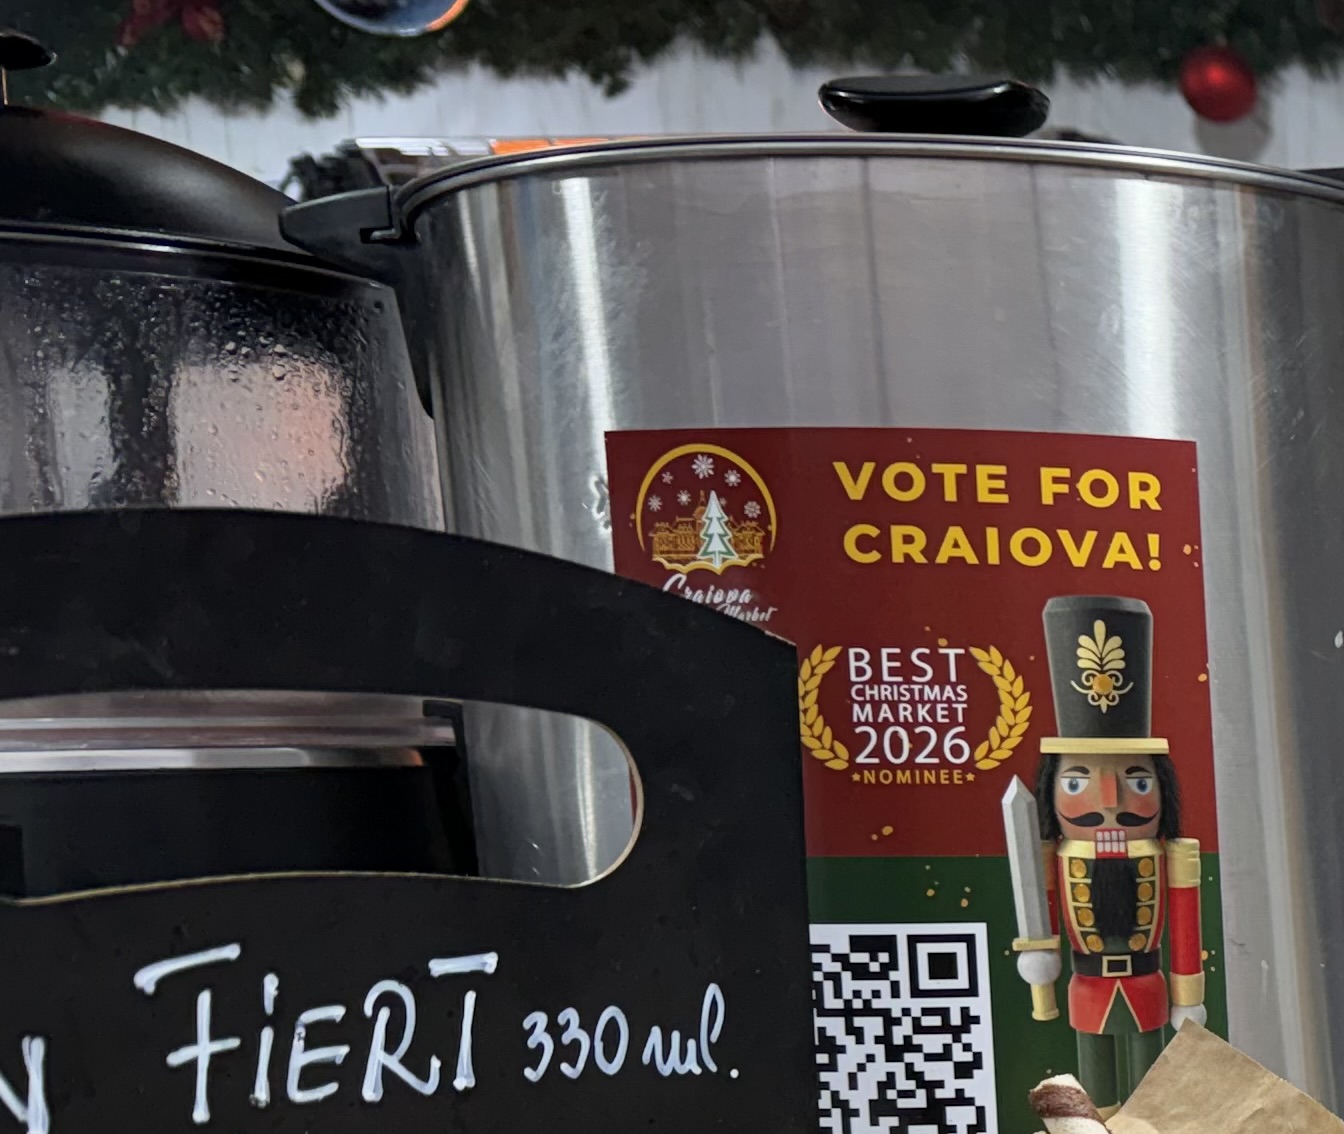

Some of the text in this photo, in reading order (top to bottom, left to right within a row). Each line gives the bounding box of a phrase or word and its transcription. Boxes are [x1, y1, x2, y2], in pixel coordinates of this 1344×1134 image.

[833, 462, 1162, 511] VOTE FOR
[843, 525, 1161, 572] CRAIOVA!
[848, 647, 966, 683] BEST
[851, 683, 968, 701] CHRISTMAS
[852, 703, 968, 724] MARKET
[855, 726, 971, 765] 2026
[863, 769, 964, 786] NOMINEE
[522, 1005, 630, 1083] 330
